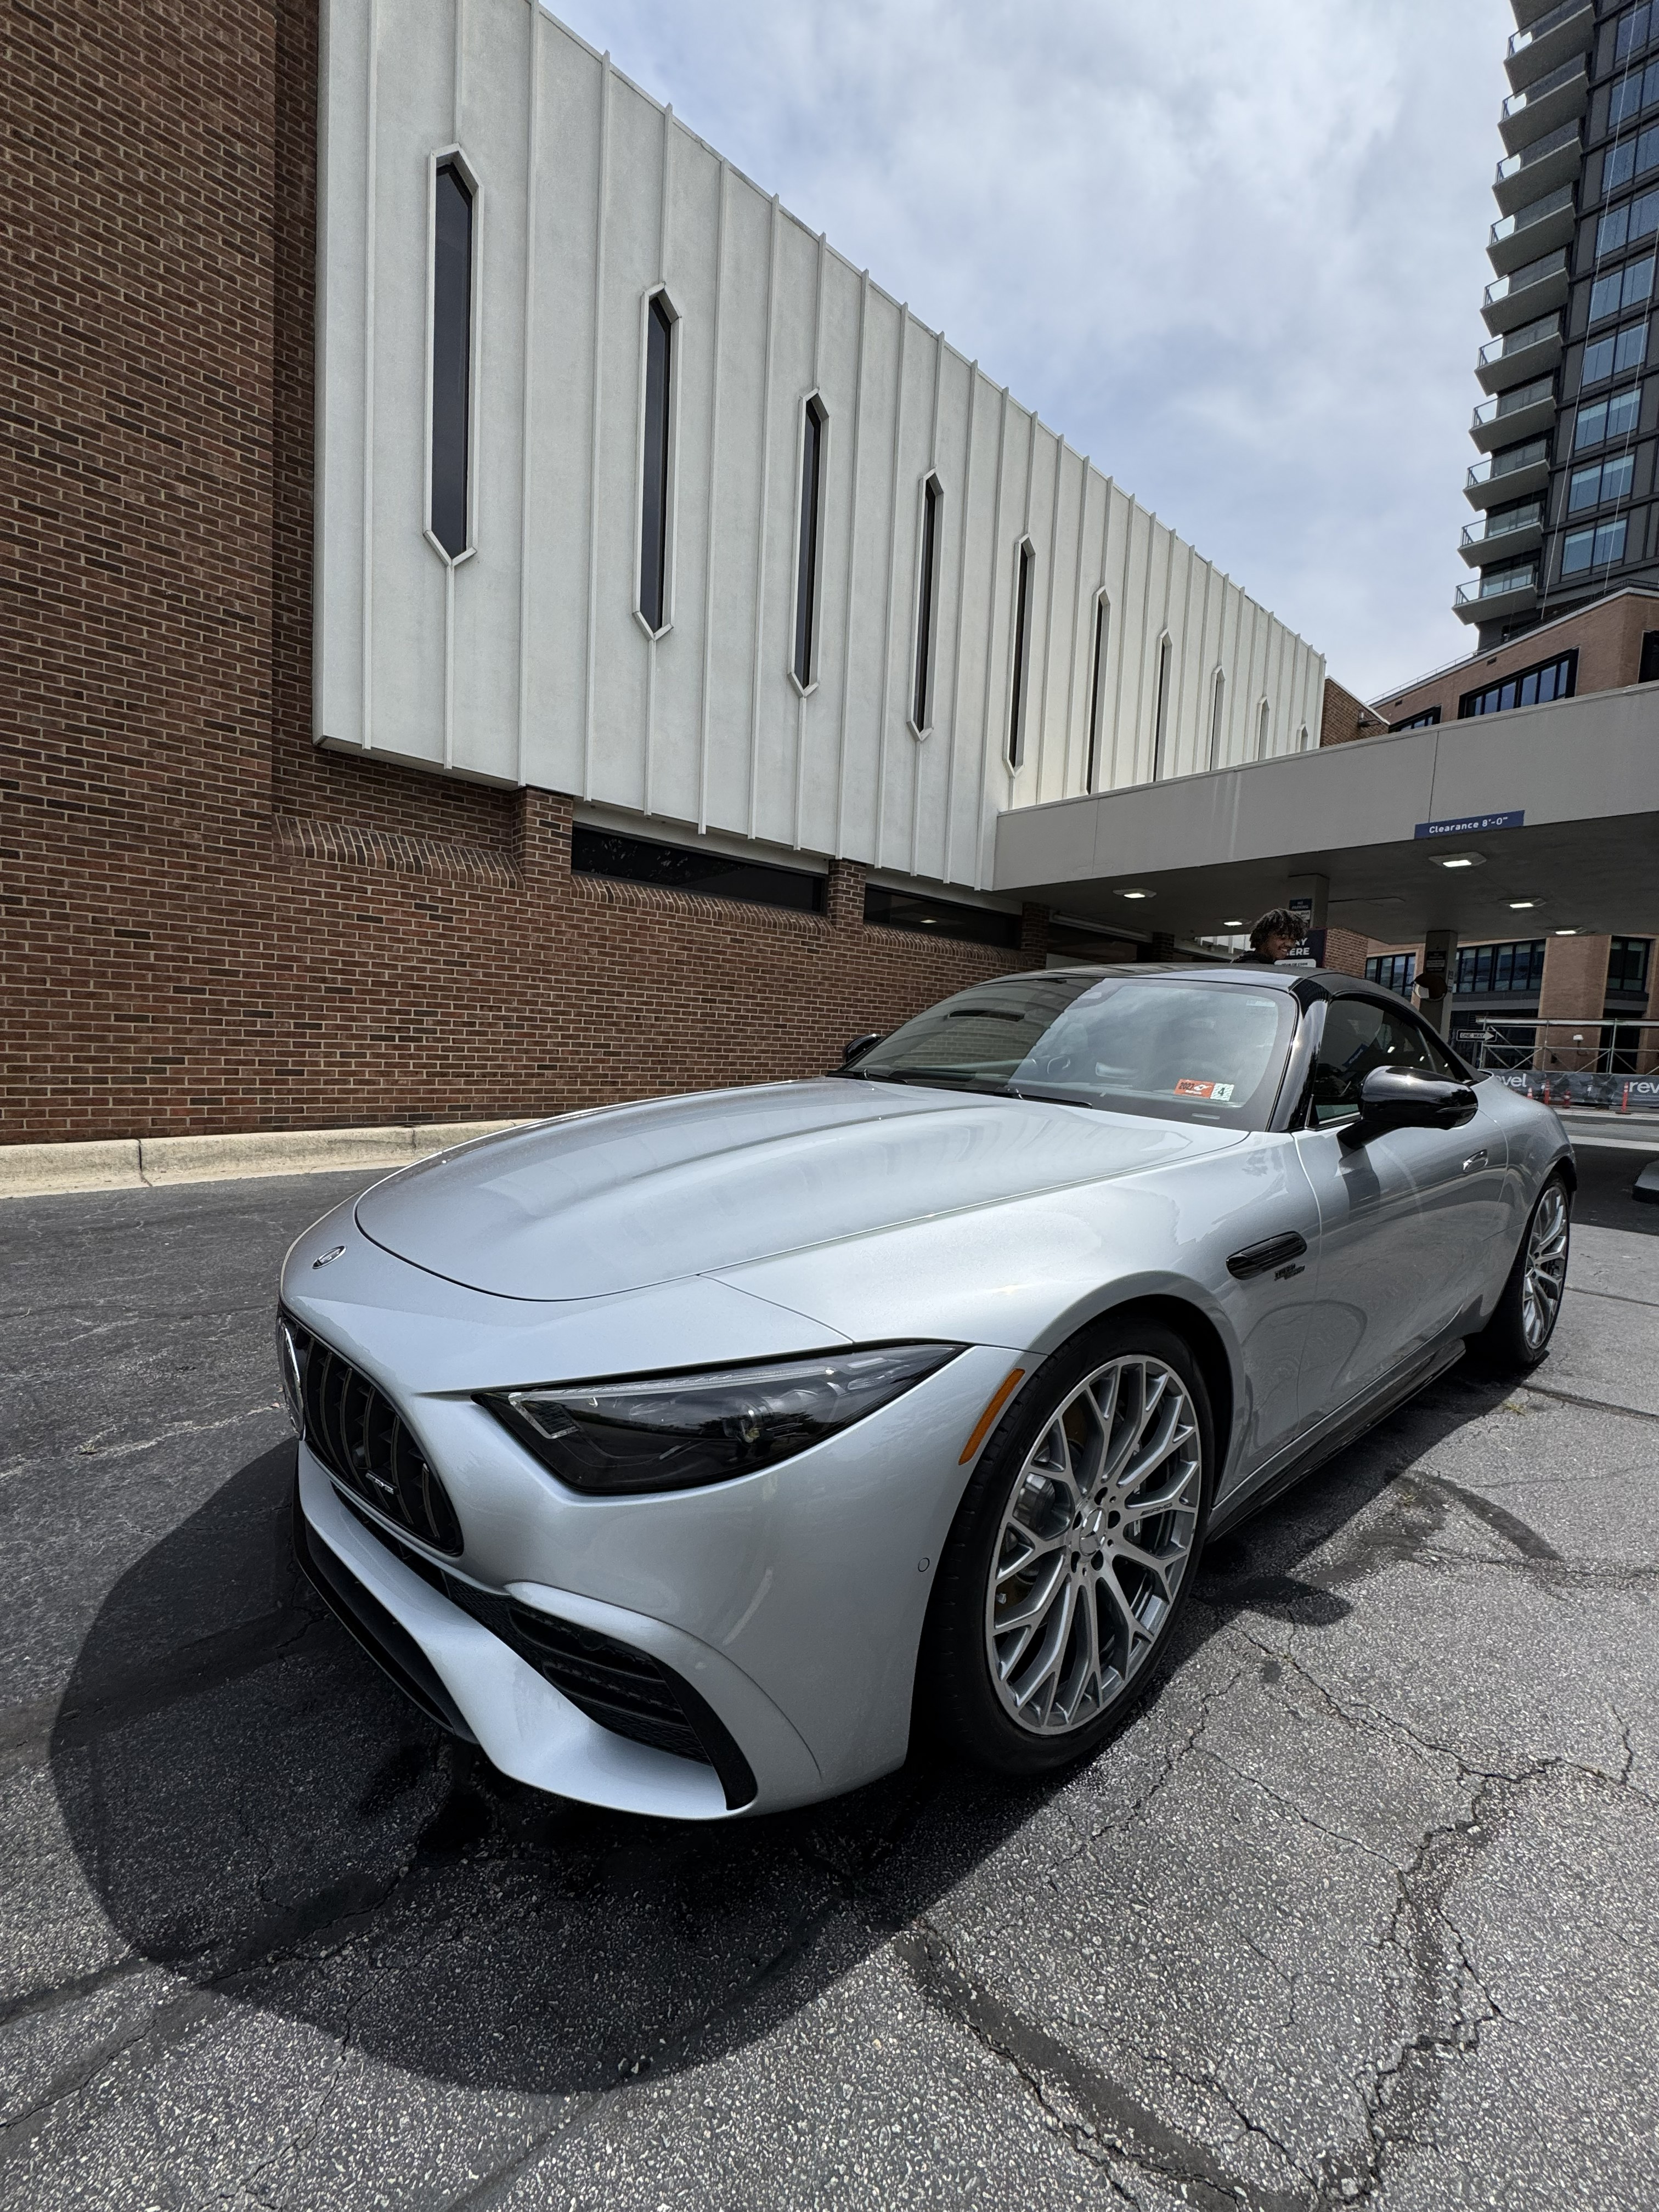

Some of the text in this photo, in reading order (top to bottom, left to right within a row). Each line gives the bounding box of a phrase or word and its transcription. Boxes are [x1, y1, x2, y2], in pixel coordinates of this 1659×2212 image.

[1429, 822, 1479, 834] Clearance
[1287, 947, 1310, 956] ERE
[1178, 1082, 1195, 1090] 2027
[1218, 1087, 1226, 1097] 4
